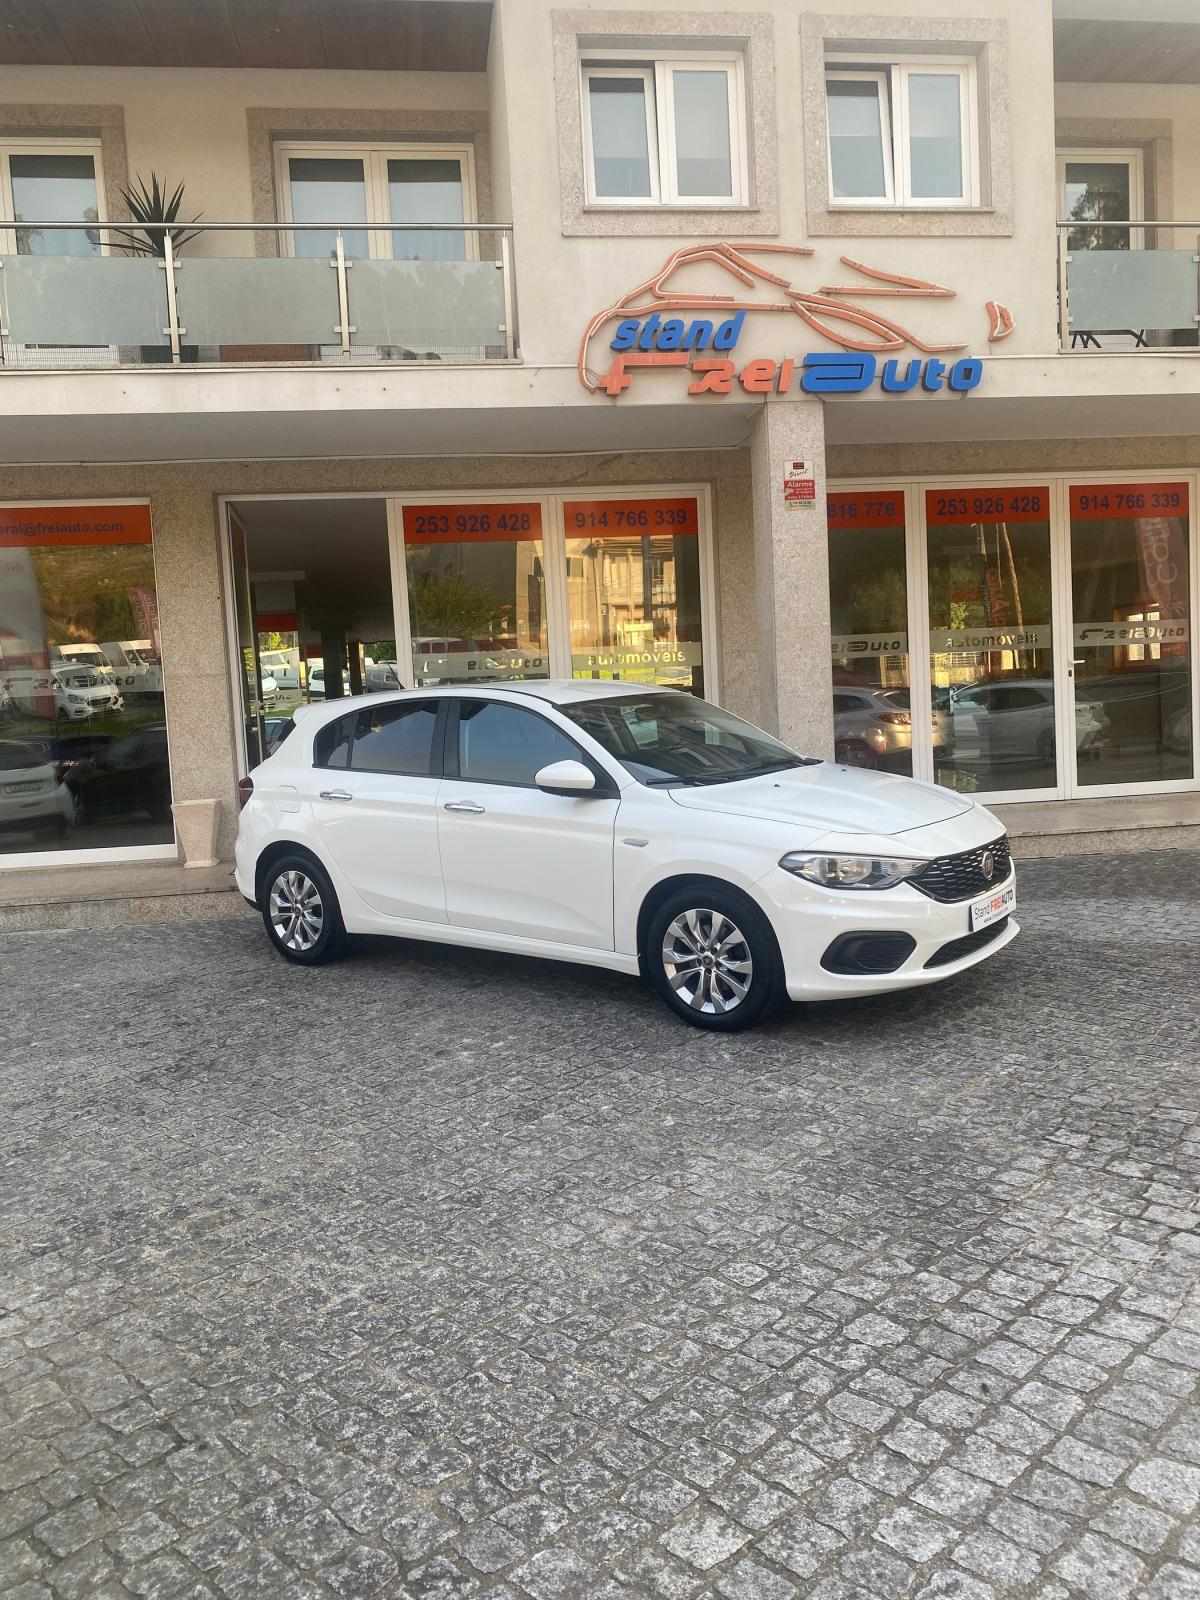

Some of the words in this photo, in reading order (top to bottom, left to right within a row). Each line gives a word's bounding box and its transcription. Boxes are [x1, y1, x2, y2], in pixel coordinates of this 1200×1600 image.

[610, 309, 747, 351] stand
[787, 480, 813, 489] Alarme
[936, 498, 966, 516] 253
[973, 497, 1005, 514] 926
[1009, 496, 1041, 513] 428
[1079, 495, 1109, 511] 914
[1114, 494, 1145, 510] 766
[1151, 493, 1181, 508] 339
[414, 515, 449, 534] 253
[455, 513, 490, 533] 926
[496, 511, 531, 531] 428
[574, 511, 609, 528] 914
[615, 510, 648, 526] 766
[654, 508, 688, 525] 339
